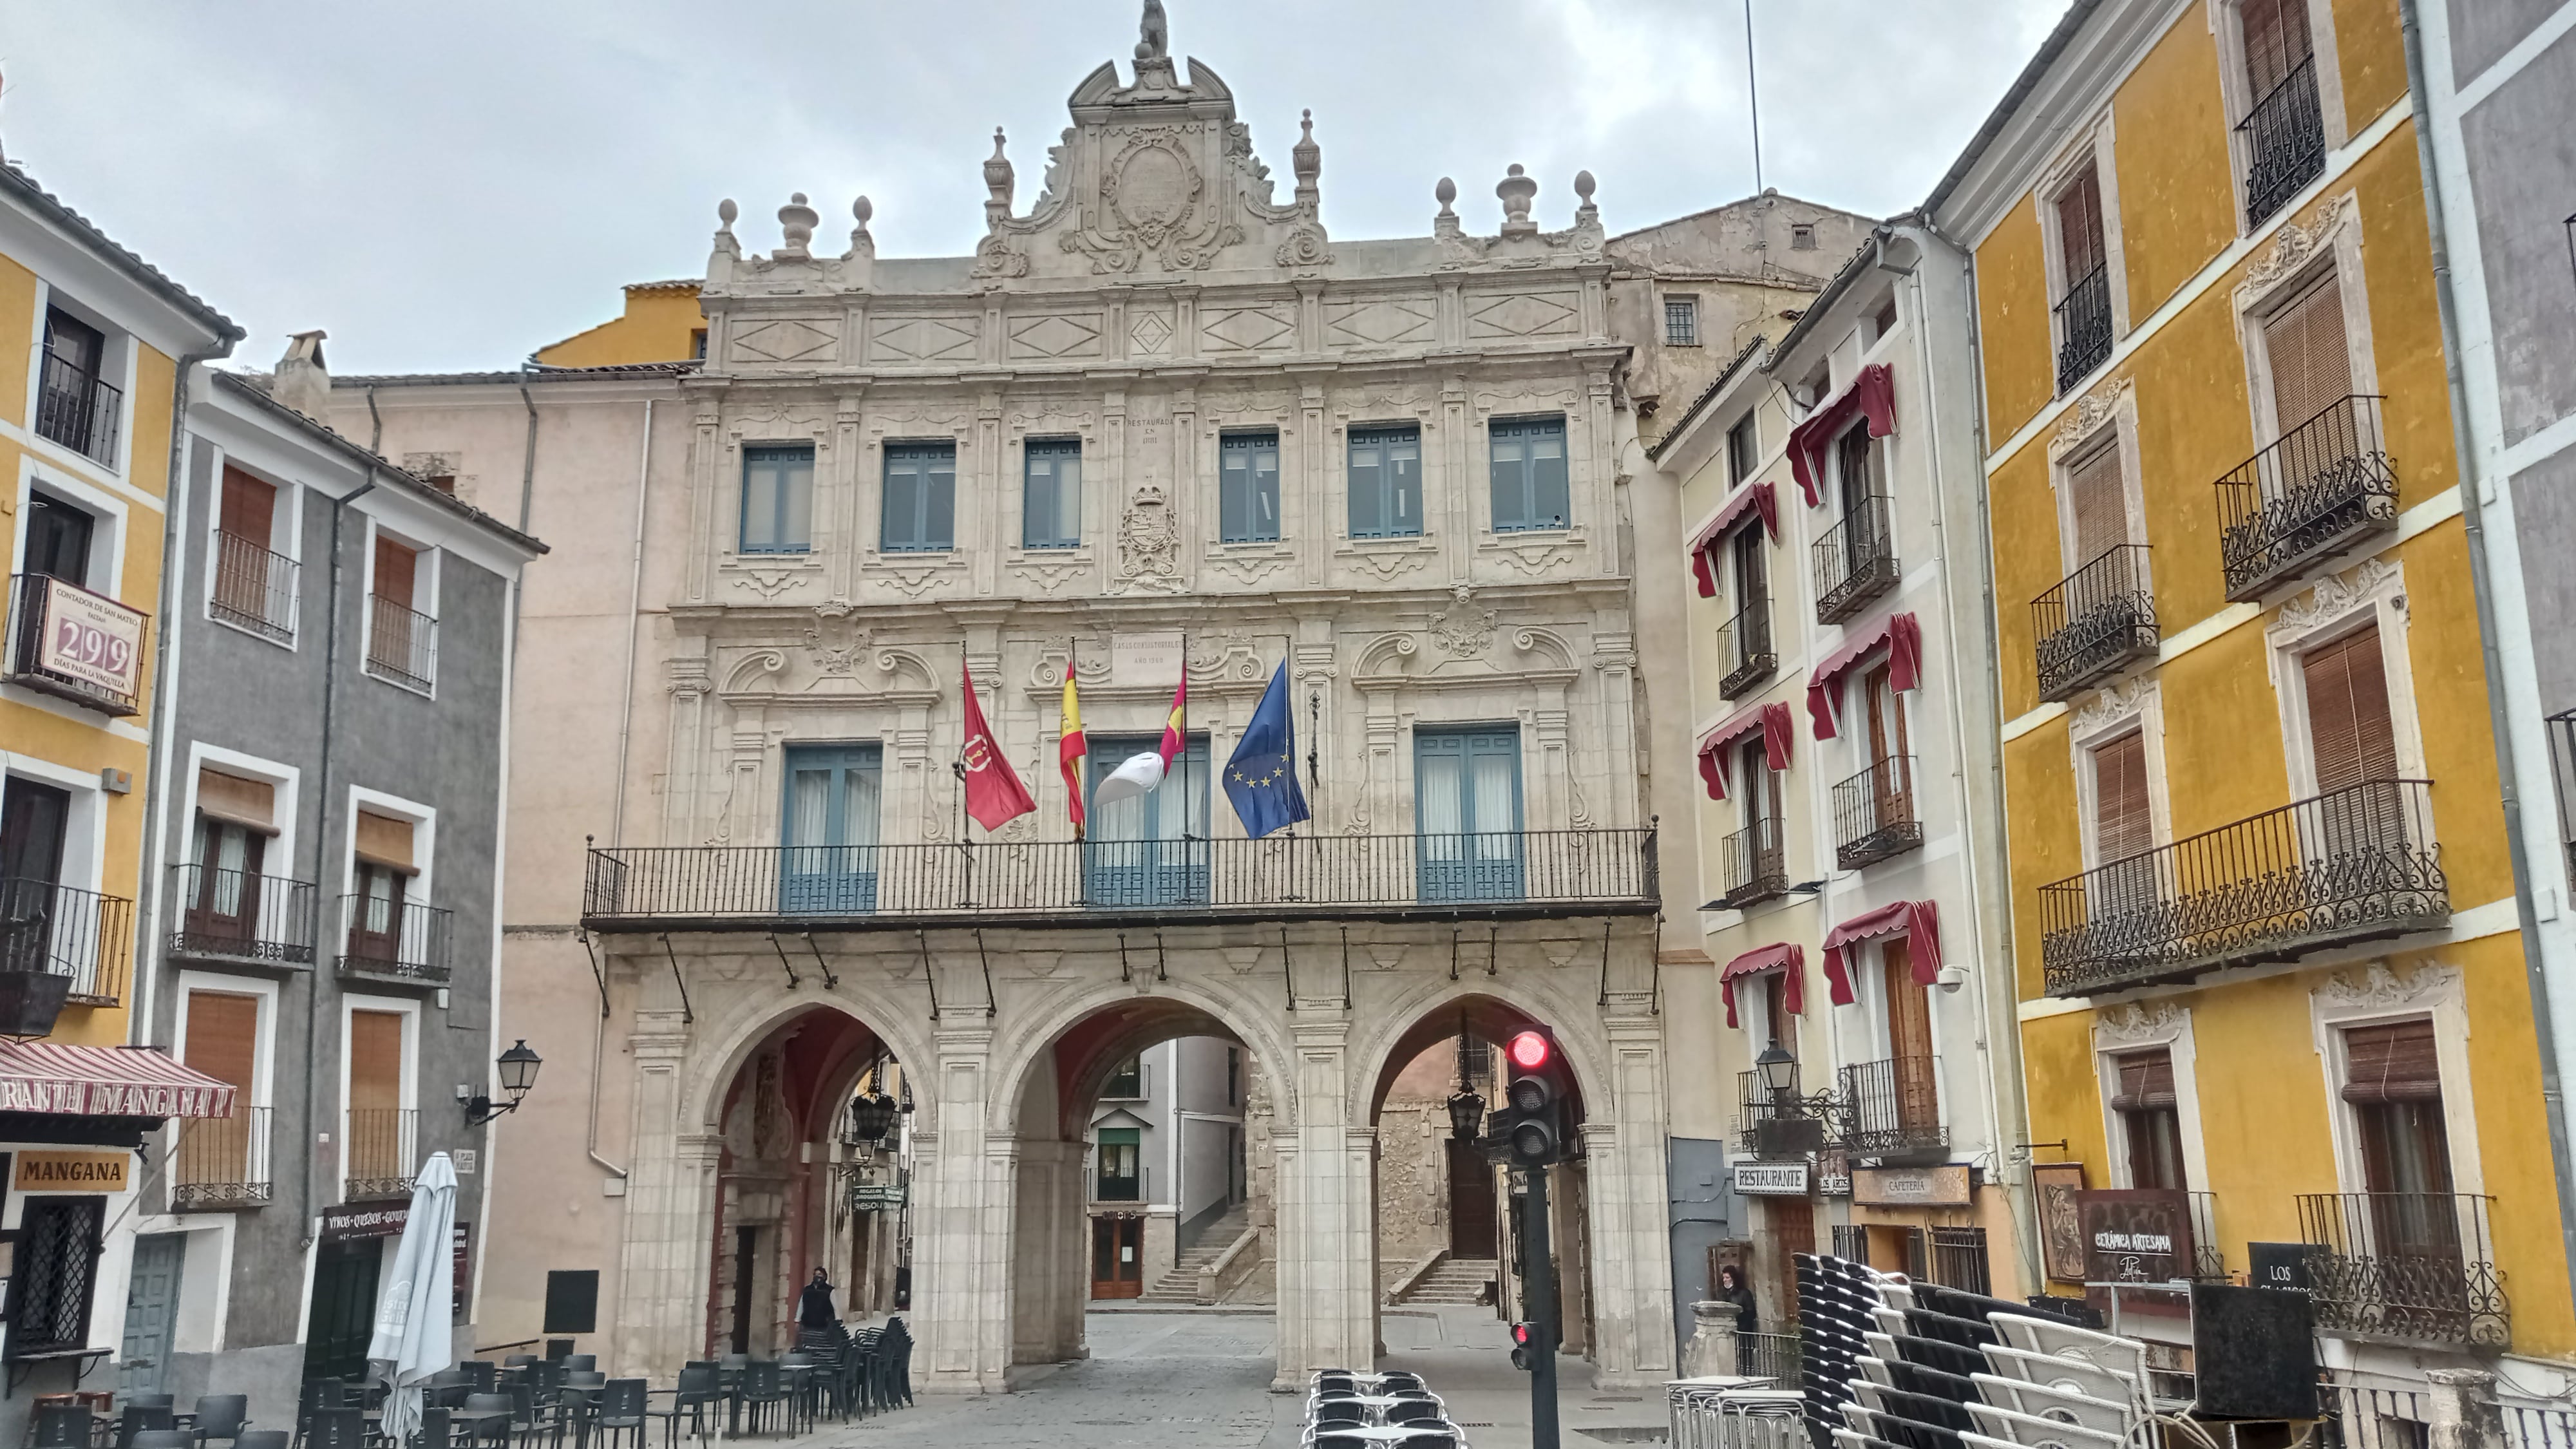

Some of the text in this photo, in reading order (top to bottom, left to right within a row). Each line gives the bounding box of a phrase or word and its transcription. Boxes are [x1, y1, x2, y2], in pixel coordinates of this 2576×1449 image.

[1128, 417, 1173, 426] RESTAURADA
[57, 589, 138, 627] CONTADOR DE SAN MATEO
[60, 621, 128, 672] 299
[54, 658, 70, 670] DÍAS
[71, 664, 87, 675] PARA
[96, 672, 125, 689] VAQUILLA
[100, 1087, 207, 1115] MANGANA
[24, 1161, 122, 1181] MANGANA
[1739, 1170, 1803, 1188] RESTAURANTE
[1821, 1179, 1830, 1188] LOS
[2095, 1229, 2172, 1253] CERÁMICA ARTESANA
[2270, 1265, 2291, 1282] LOS
